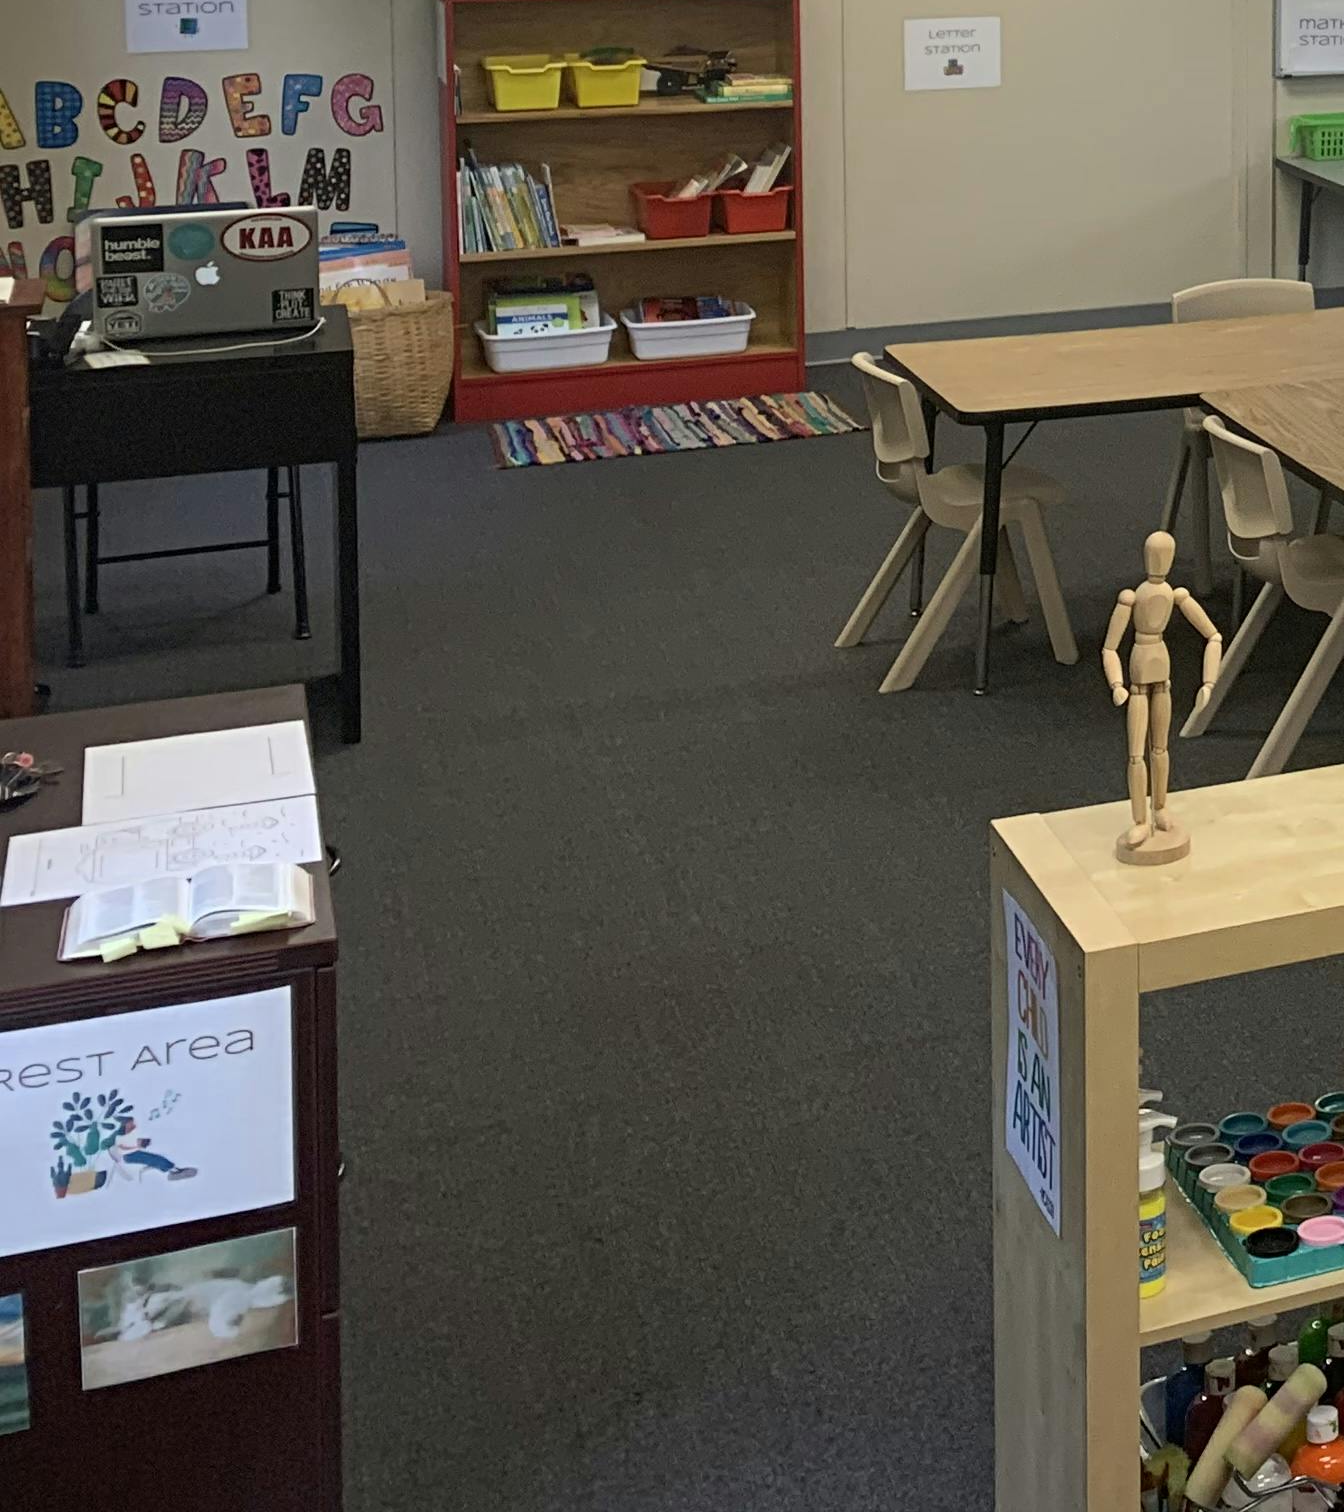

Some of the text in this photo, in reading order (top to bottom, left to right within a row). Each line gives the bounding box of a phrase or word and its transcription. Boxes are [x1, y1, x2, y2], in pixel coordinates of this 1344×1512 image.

[104, 237, 161, 252] humble
[239, 226, 294, 250] KAA
[275, 307, 311, 320] CREATE
[1014, 911, 1050, 1001] EVERY
[1017, 1026, 1051, 1124] IS AN
[1013, 1088, 1056, 1191] ARTIST
